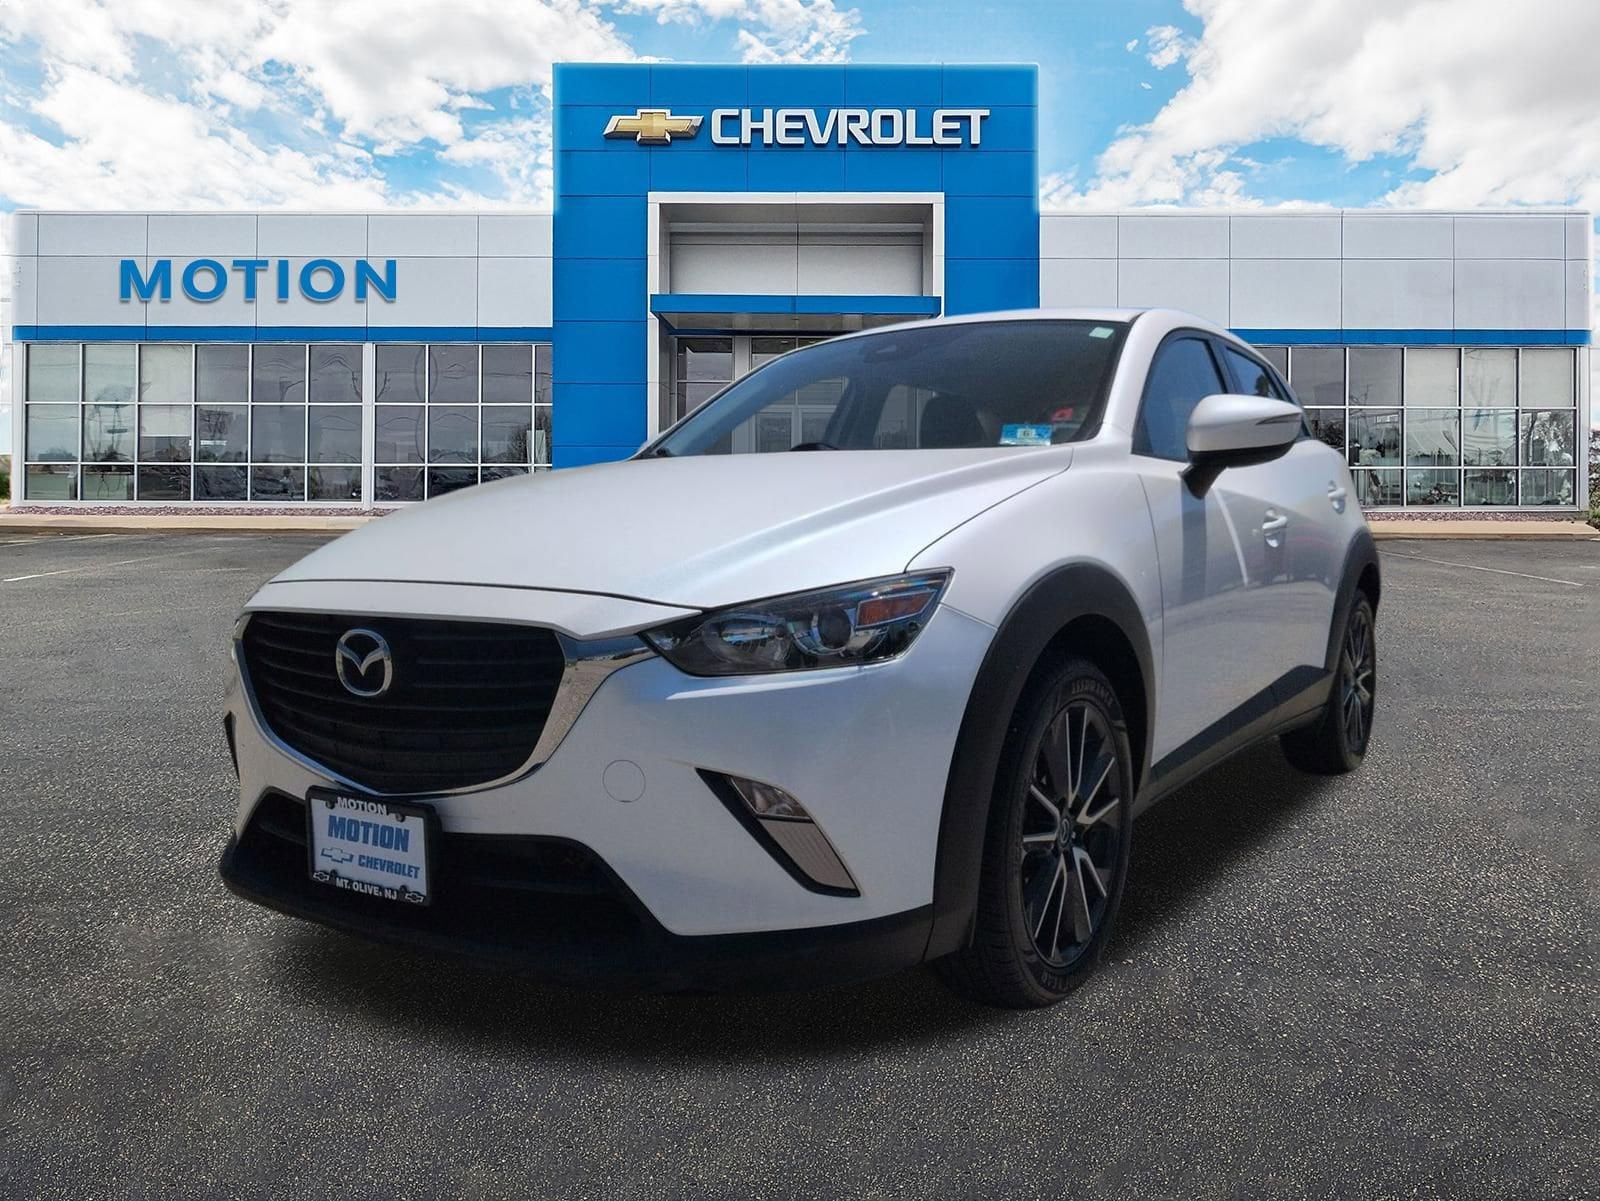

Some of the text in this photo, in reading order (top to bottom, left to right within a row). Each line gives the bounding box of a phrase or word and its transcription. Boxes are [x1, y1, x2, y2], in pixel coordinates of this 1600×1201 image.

[711, 108, 990, 145] CHEVROLET
[119, 258, 397, 303] MOTION
[336, 797, 387, 816] MOTION
[328, 815, 410, 852] MOTION
[358, 854, 420, 879] CHEVROLET
[335, 877, 350, 889] MT.
[384, 888, 397, 900] NJ
